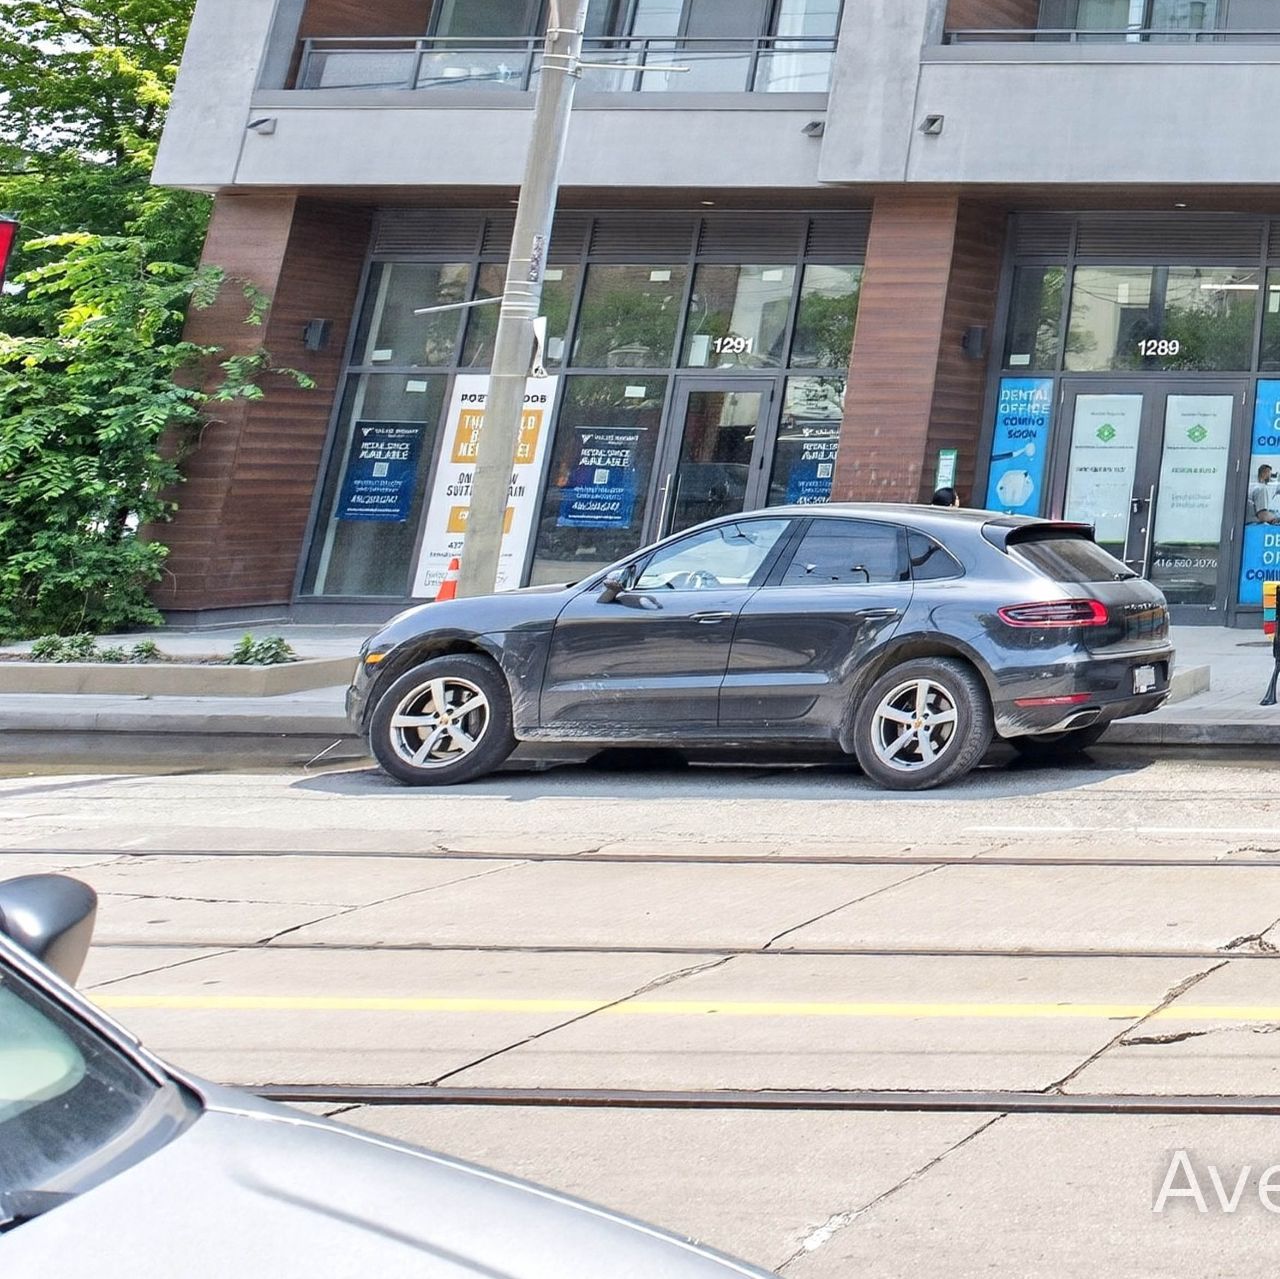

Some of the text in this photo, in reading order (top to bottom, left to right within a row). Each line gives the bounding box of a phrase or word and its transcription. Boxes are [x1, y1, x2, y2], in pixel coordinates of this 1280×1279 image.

[713, 336, 753, 354] 1291
[1137, 339, 1180, 356] 1289
[1001, 389, 1048, 401] DENTAL
[1000, 403, 1050, 414] OFFICE
[1007, 429, 1037, 438] SOON
